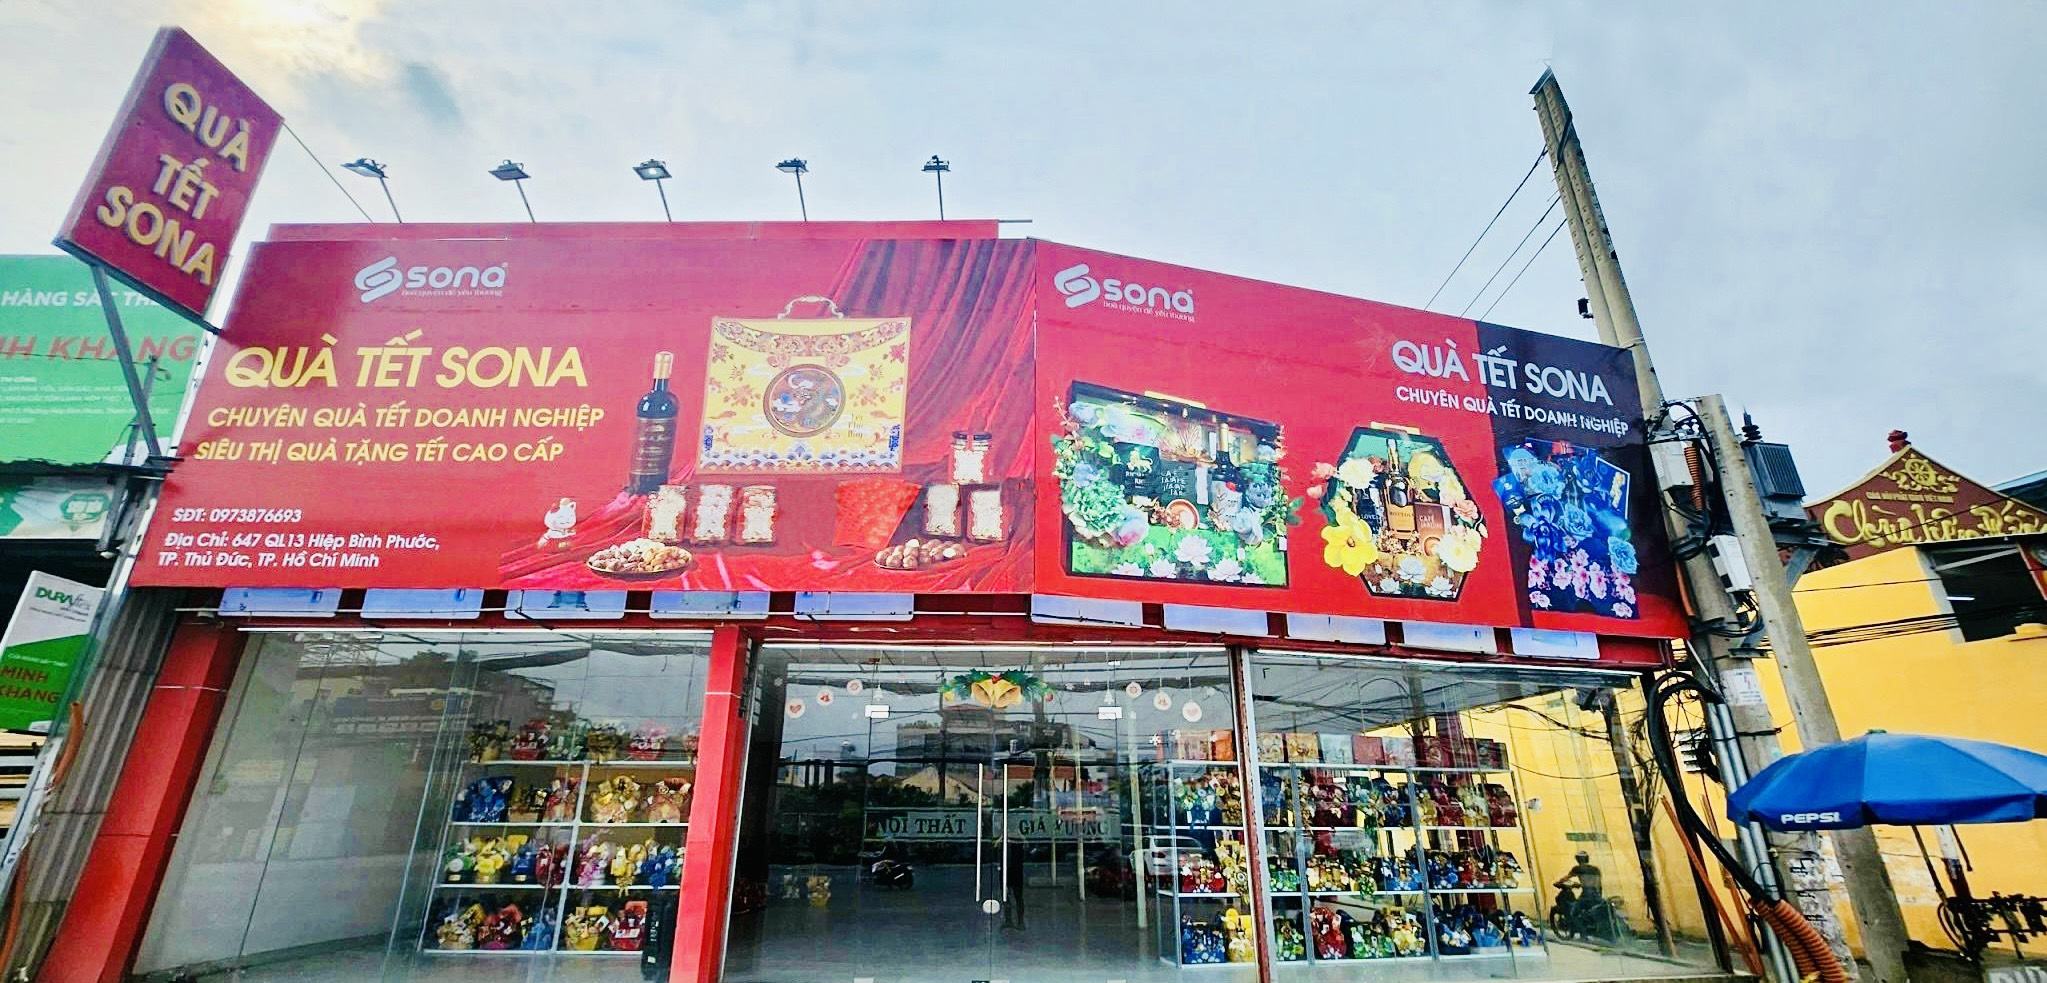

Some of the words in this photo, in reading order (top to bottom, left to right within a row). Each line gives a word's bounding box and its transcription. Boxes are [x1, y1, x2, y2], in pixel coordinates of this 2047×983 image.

[164, 82, 250, 173] QUÀ
[152, 153, 220, 220] TẾT
[96, 186, 216, 286] SONA
[405, 265, 506, 289] sona
[1, 287, 67, 307] HÀNG
[1103, 278, 1195, 314] sona
[224, 332, 338, 388] QUÀ
[356, 328, 433, 388] TẾT
[435, 346, 588, 388] SONA
[1391, 338, 1470, 382] QUÀ
[1472, 344, 1518, 390] TẾT
[1525, 362, 1614, 406] SONA
[207, 403, 307, 427] CHUYÊN
[312, 402, 367, 428] QUÀ
[375, 400, 411, 428] TẾT
[414, 408, 507, 428] DOANH
[512, 403, 605, 432] NGHIỆP
[1396, 385, 1460, 410] CHUYÊN
[1463, 396, 1499, 415] QUÀ
[1500, 398, 1521, 419] TẾT
[1525, 406, 1577, 428] DOANH
[1580, 414, 1629, 439] NGHIỆP
[193, 437, 243, 460] SIÊU
[248, 438, 284, 465] THỊ
[286, 437, 337, 461] QUÀ
[345, 438, 409, 466] TẶNG
[415, 435, 449, 462] TẾT
[452, 443, 508, 462] CAO
[513, 435, 564, 462] CẤP
[172, 509, 207, 523] SĐT:
[209, 508, 302, 523] 0973876693
[164, 533, 193, 549] Địa
[197, 531, 229, 547] Chỉ:
[231, 533, 262, 547] 647
[264, 533, 304, 547] QL13
[307, 533, 345, 552] Hiệp
[348, 532, 382, 548] Bình
[385, 534, 441, 550] Phước,
[158, 551, 180, 566] TP.
[184, 551, 212, 567] Thủ
[215, 551, 253, 568] Đức,
[257, 552, 277, 567] TP.
[282, 550, 306, 567] Hồ
[309, 551, 340, 567] Chí
[339, 553, 379, 567] Minh
[915, 813, 966, 834] THẤT
[1781, 811, 1842, 825] PEPSI
